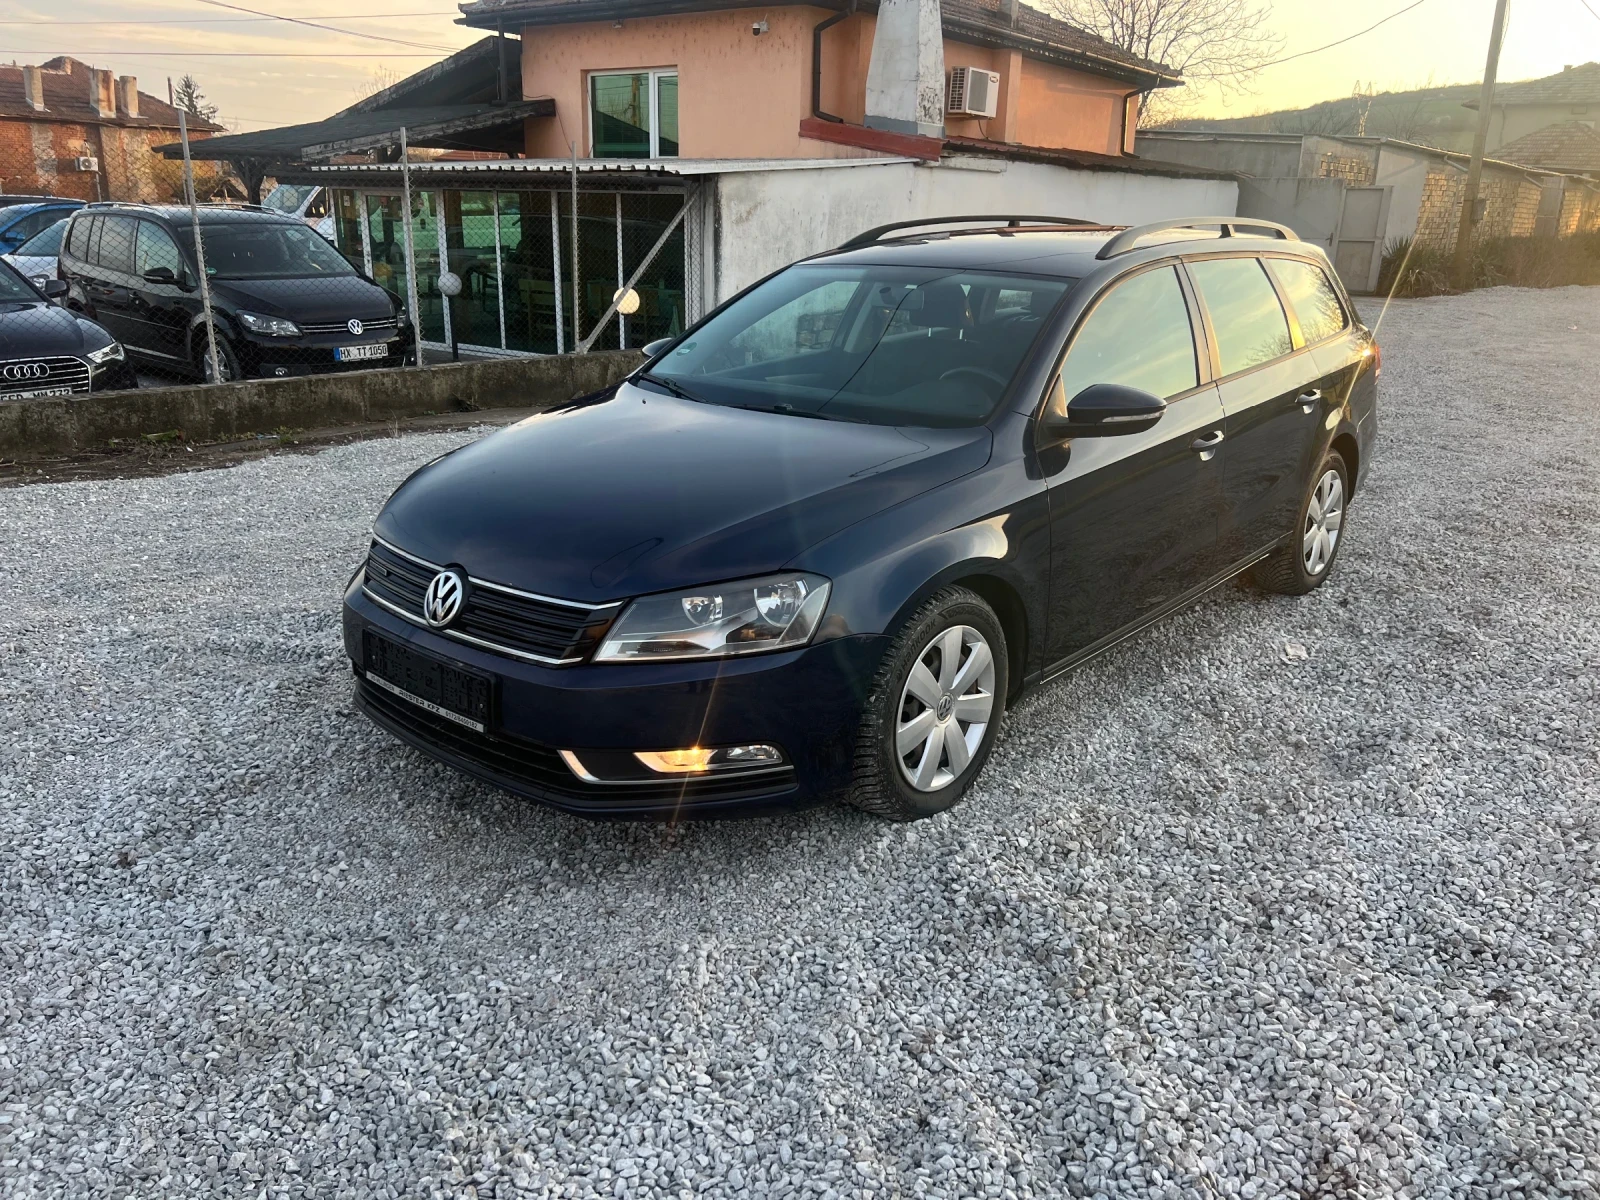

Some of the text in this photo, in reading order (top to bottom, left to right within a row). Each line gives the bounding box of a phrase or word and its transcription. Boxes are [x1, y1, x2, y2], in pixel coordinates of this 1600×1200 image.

[340, 344, 387, 359] HX TT 1050
[399, 689, 425, 707] RIESTER
[427, 702, 441, 714] KFZ
